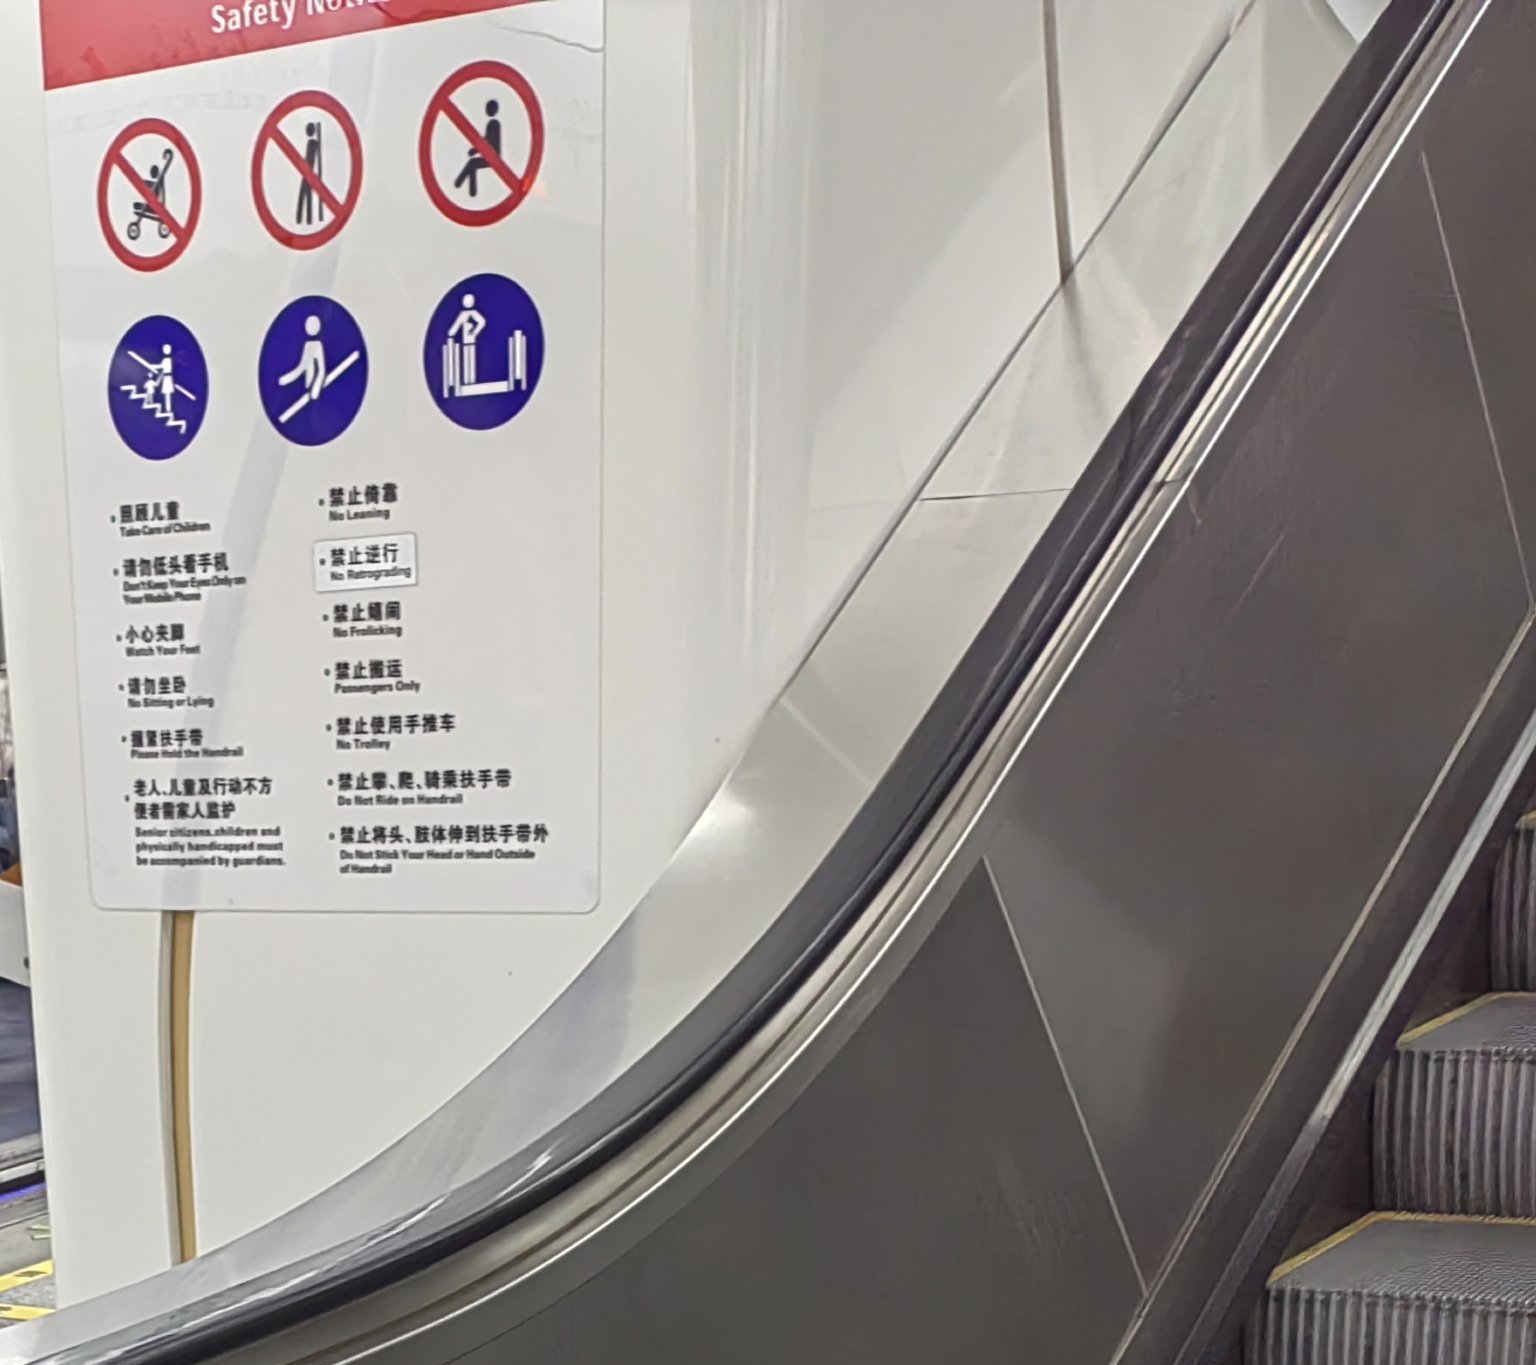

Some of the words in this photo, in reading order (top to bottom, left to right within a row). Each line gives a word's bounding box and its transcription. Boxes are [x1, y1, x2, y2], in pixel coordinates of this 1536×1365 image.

[211, 0, 296, 34] Safety
[329, 482, 398, 507] 禁止倚靠
[329, 510, 345, 521] No
[347, 508, 390, 520] Leaning
[173, 521, 211, 532] Children
[330, 543, 398, 567] 禁止逆行
[123, 552, 228, 577] 请勿低头看手机
[330, 571, 344, 581] No
[347, 566, 411, 581] Retrograding
[333, 627, 348, 638] No
[350, 625, 402, 638] Frolicking
[126, 646, 154, 656] Watch
[156, 645, 177, 655] Your
[180, 644, 200, 654] Feet
[334, 683, 393, 694] Passengers
[395, 680, 421, 693] Only
[128, 698, 141, 708] No
[187, 696, 214, 708] Lying
[336, 713, 456, 735] 禁止使用手推车
[336, 739, 351, 750] No
[354, 738, 390, 750] Trolley
[201, 746, 243, 757] Handrail
[338, 795, 352, 806] Do
[354, 795, 373, 806] Not
[376, 794, 399, 805] Ride
[417, 793, 463, 804] Handrail
[135, 827, 167, 837] Senior
[260, 826, 280, 836] and
[135, 842, 185, 854] physically
[187, 841, 255, 853] handicapped
[257, 842, 284, 851] must
[340, 851, 354, 860] Do
[355, 850, 373, 860] Not
[375, 849, 399, 859] Stick
[401, 850, 424, 859] Your
[426, 849, 453, 859] Head
[466, 849, 493, 859] Hand
[494, 848, 535, 859] Outside
[150, 856, 216, 868] accompanied
[217, 856, 230, 868] by
[351, 864, 392, 874] Handrail
